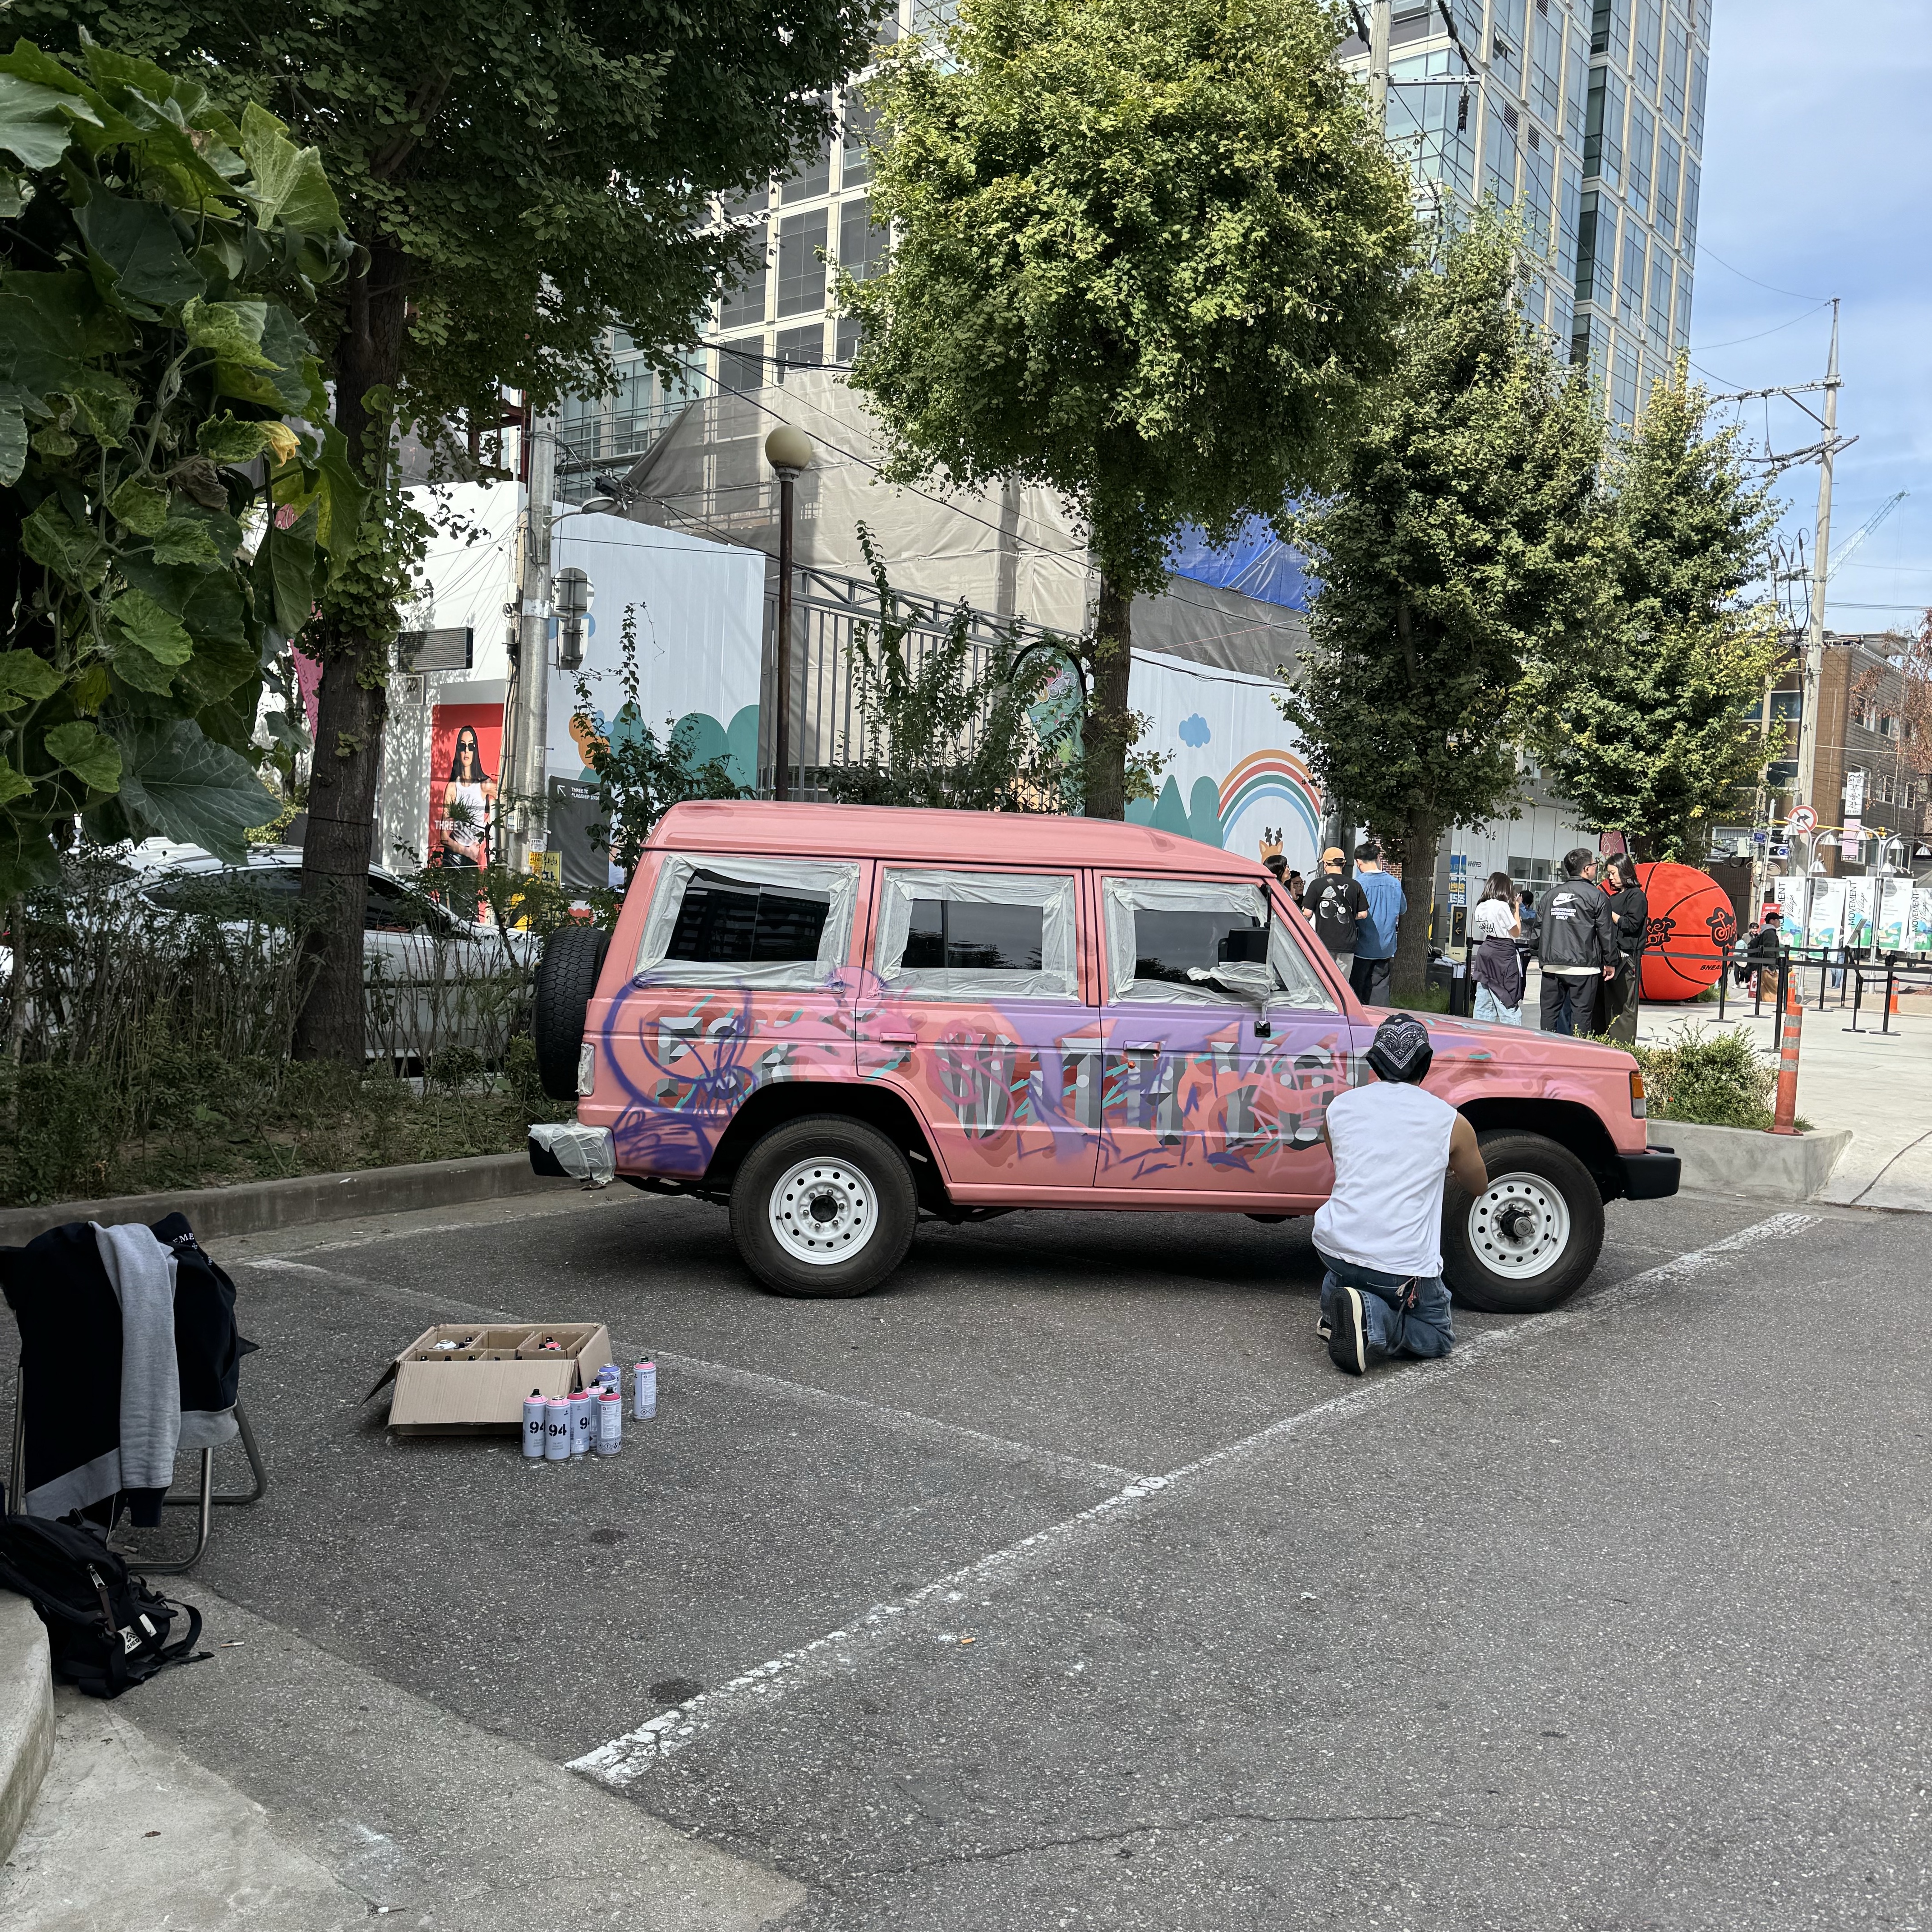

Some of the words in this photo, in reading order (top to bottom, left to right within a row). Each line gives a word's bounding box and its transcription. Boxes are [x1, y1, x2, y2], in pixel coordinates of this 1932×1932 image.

[1848, 882, 1857, 925] MOVEMENT
[1455, 911, 1463, 923] P
[549, 1423, 567, 1437] 94
